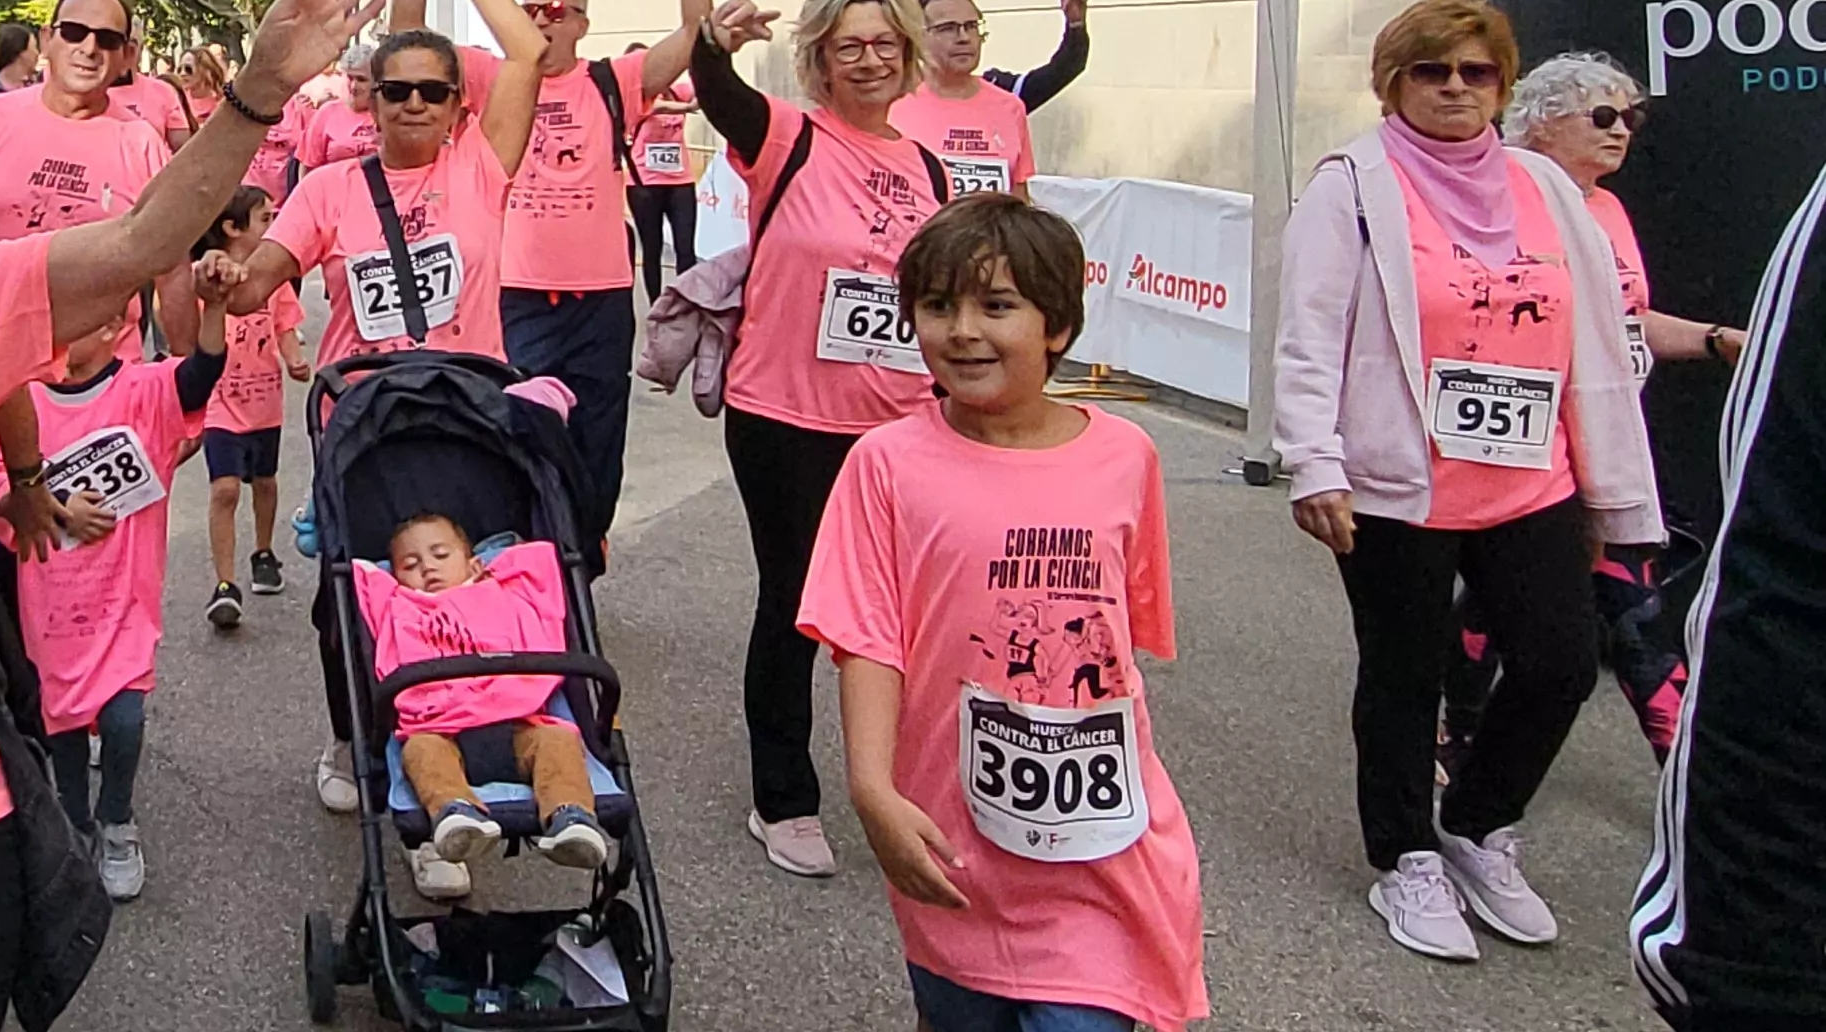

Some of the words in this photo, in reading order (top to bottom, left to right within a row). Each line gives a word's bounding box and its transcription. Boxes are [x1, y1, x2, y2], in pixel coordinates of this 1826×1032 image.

[1743, 66, 1826, 93] POD
[360, 264, 395, 279] CONTR
[1126, 253, 1228, 312] Alcampo
[847, 305, 916, 344] 620
[1447, 379, 1496, 395] CONTRA
[1496, 385, 1510, 396] EL
[1456, 397, 1534, 439] 951
[1005, 528, 1093, 558] CORRAMOS
[988, 560, 1019, 590] POR
[1023, 559, 1042, 589] LA
[1046, 559, 1102, 590] CIENCIA
[978, 716, 1042, 751] CONTRA
[1046, 738, 1061, 752] EL
[1063, 729, 1117, 749] CÁNCER
[974, 739, 1123, 815] 3908
